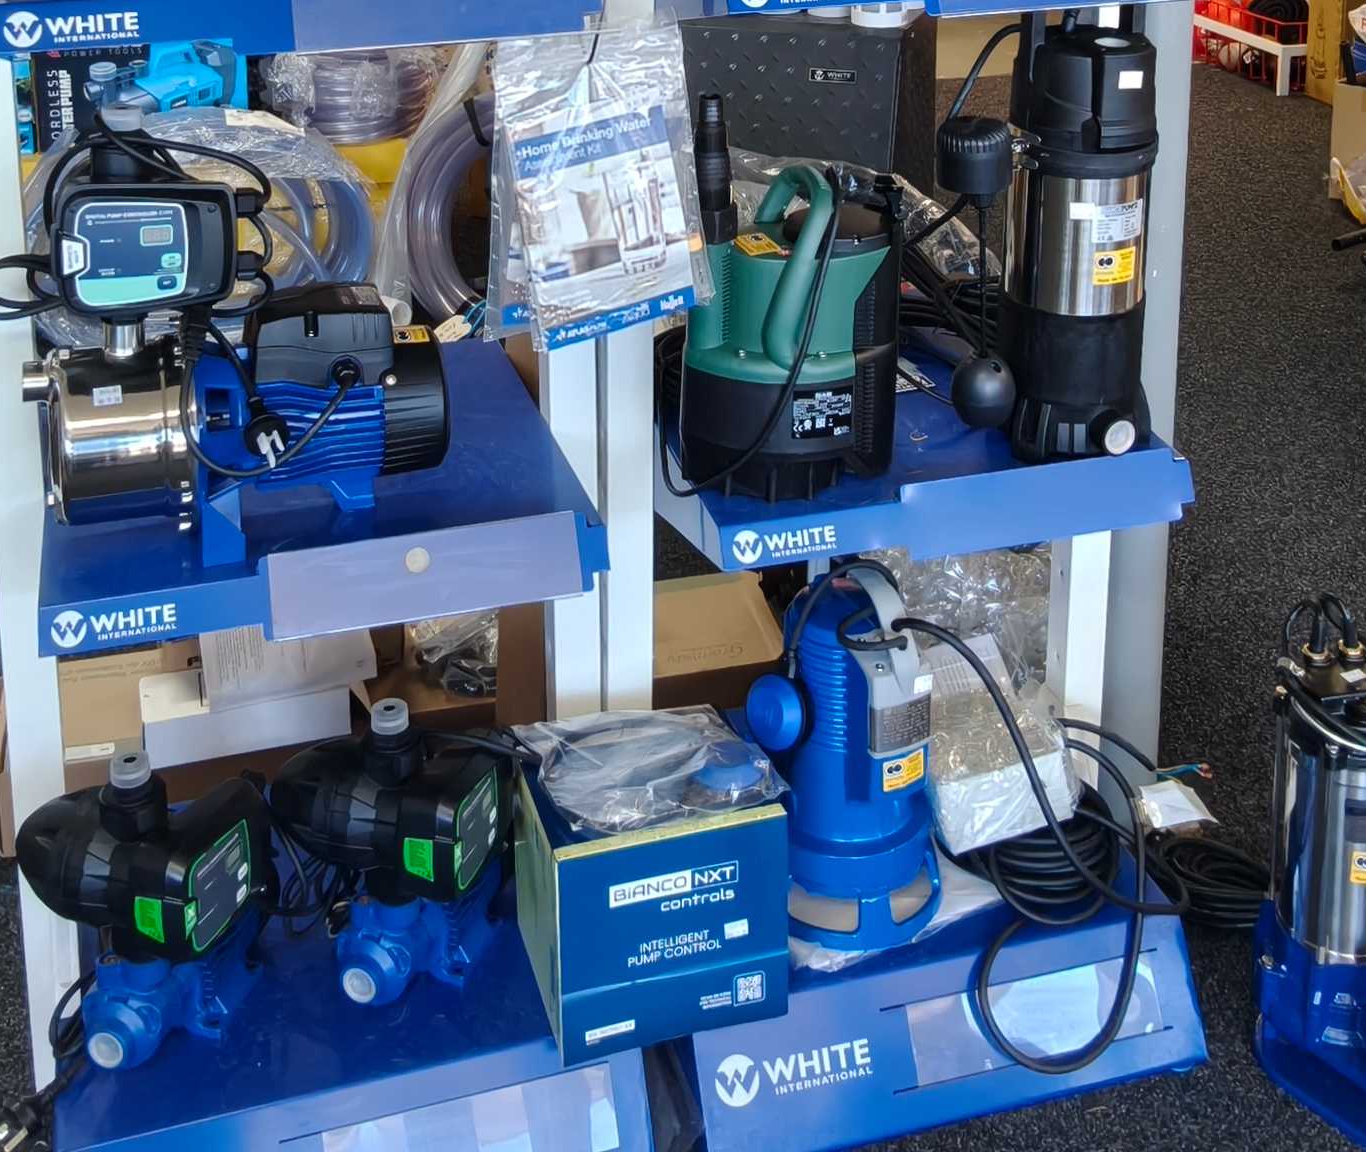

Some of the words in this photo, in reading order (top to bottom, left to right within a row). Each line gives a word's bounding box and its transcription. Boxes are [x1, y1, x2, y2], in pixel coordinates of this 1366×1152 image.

[45, 11, 139, 35] WHITE
[54, 32, 140, 44] INTERNATIONAL
[828, 71, 852, 80] WHITE
[46, 70, 62, 141] ORDLESS
[61, 70, 73, 129] TERPUMP
[522, 140, 559, 158] Home
[562, 126, 614, 148] Drinking
[614, 117, 651, 135] Water
[762, 526, 836, 552] WHITE
[771, 542, 837, 559] INTERNATIONAL
[90, 602, 176, 632] WHITE
[97, 621, 177, 641] INTERNATIONAL
[614, 876, 687, 904] BIANCO
[694, 865, 736, 886] NXT
[660, 888, 735, 912] controls
[627, 950, 661, 968] PUMP
[663, 939, 722, 960] CONTROL
[639, 929, 710, 953] INTELLIGENT
[763, 1038, 871, 1080] WHITE
[774, 1065, 873, 1095] INTERNATIONAL
